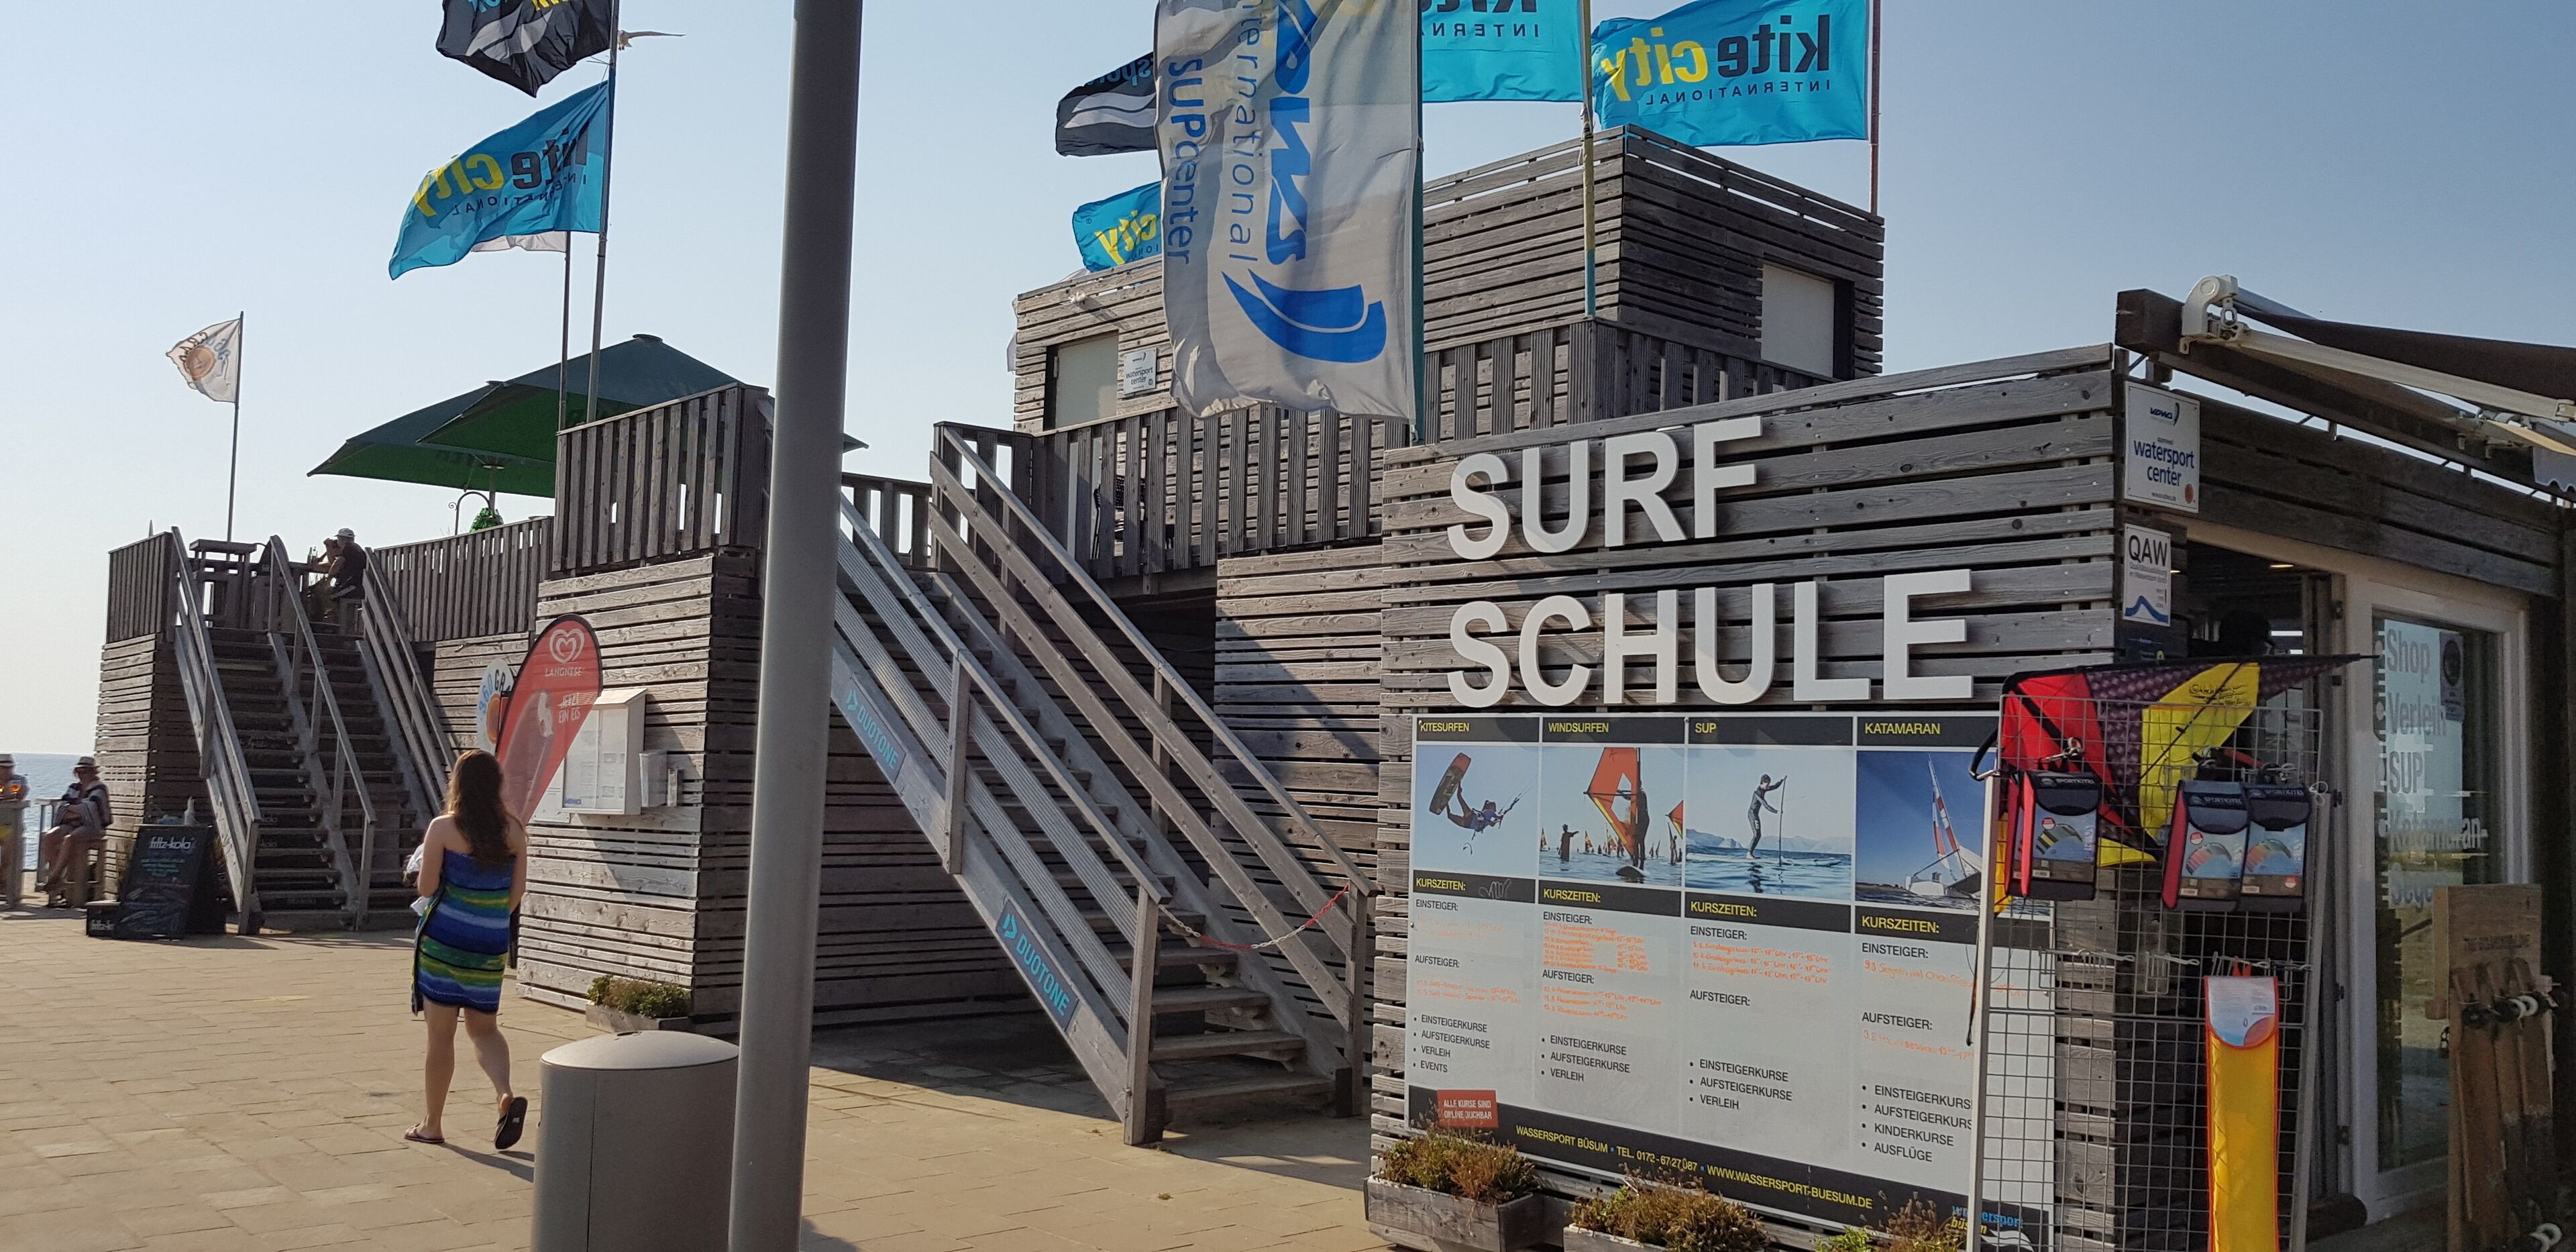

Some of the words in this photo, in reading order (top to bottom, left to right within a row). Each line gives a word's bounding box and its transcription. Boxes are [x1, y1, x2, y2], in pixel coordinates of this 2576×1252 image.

[2133, 440, 2194, 470] watersport
[2147, 465, 2182, 487] center
[1447, 415, 1762, 560] SURF
[2129, 535, 2167, 567] QAW
[1447, 569, 1974, 709] SCHULE
[2386, 629, 2431, 684] Shop
[545, 667, 582, 677] LANGNESE
[558, 709, 569, 724] EIN
[572, 707, 581, 721] EIS
[2388, 692, 2447, 736] Verleih
[1419, 722, 1469, 732] KITESURFEN
[1548, 722, 1609, 733] WINDSURFEN
[1695, 723, 1717, 733] SUP
[1864, 723, 1940, 735] KATAMARAN
[856, 705, 899, 770] DUOTONE
[2389, 750, 2424, 794] SUP
[1416, 878, 1466, 890] KURSZEITEN:
[1544, 888, 1601, 902] KURSZEITEN:
[1415, 899, 1458, 910] EINSTEIGER:
[1690, 901, 1758, 917] KURSZEITEN:
[1543, 911, 1593, 925] EINSTEIGER:
[1862, 916, 1939, 933] KURSZEITEN:
[1690, 926, 1748, 940] EINSTEIGER:
[1862, 943, 1929, 959] EINSTEIGER:
[1415, 955, 1460, 968] AUFSTEIGER:
[1016, 933, 1070, 1017] DUOTONE
[1542, 970, 1595, 984] AUFSTEIGER:
[1690, 990, 1751, 1006] AUFSTEIGER:
[1421, 1014, 1487, 1033] EINSTEIGERKURSE
[1862, 1012, 1933, 1031] AUFSTEIGER:
[1421, 1030, 1491, 1049] AUFSTEIGERKURSE
[1550, 1035, 1627, 1055] EINSTEIGERKURSE
[1421, 1045, 1450, 1058] VERLEIH
[1420, 1061, 1448, 1073] EVENTS
[1550, 1051, 1631, 1074] AUFSTEIGERKURSE
[1700, 1059, 1788, 1082] EINSTEIGERKURSE
[1550, 1067, 1584, 1082] VERLEIH
[1700, 1076, 1792, 1101] AUFSTEIGERKURSE
[1874, 1085, 1973, 1110] EINSTEIGERKURS
[1444, 1099, 1457, 1107] ALLE
[1458, 1099, 1477, 1108] KURSE
[1477, 1100, 1491, 1108] SIND
[1700, 1094, 1739, 1110] VERLEIH
[1874, 1104, 1972, 1130] AUFSTEIGERKURS
[1874, 1123, 1954, 1147] KINDERKURSE
[1874, 1142, 1933, 1162] AUSFLÜGE
[1515, 1125, 1576, 1145] WASSERSPORT
[1577, 1137, 1608, 1153] BÜSUM
[1616, 1145, 1635, 1159] TEL.
[1707, 1165, 1873, 1209] WWW.WASSERSPORT-BUESUM.DE
